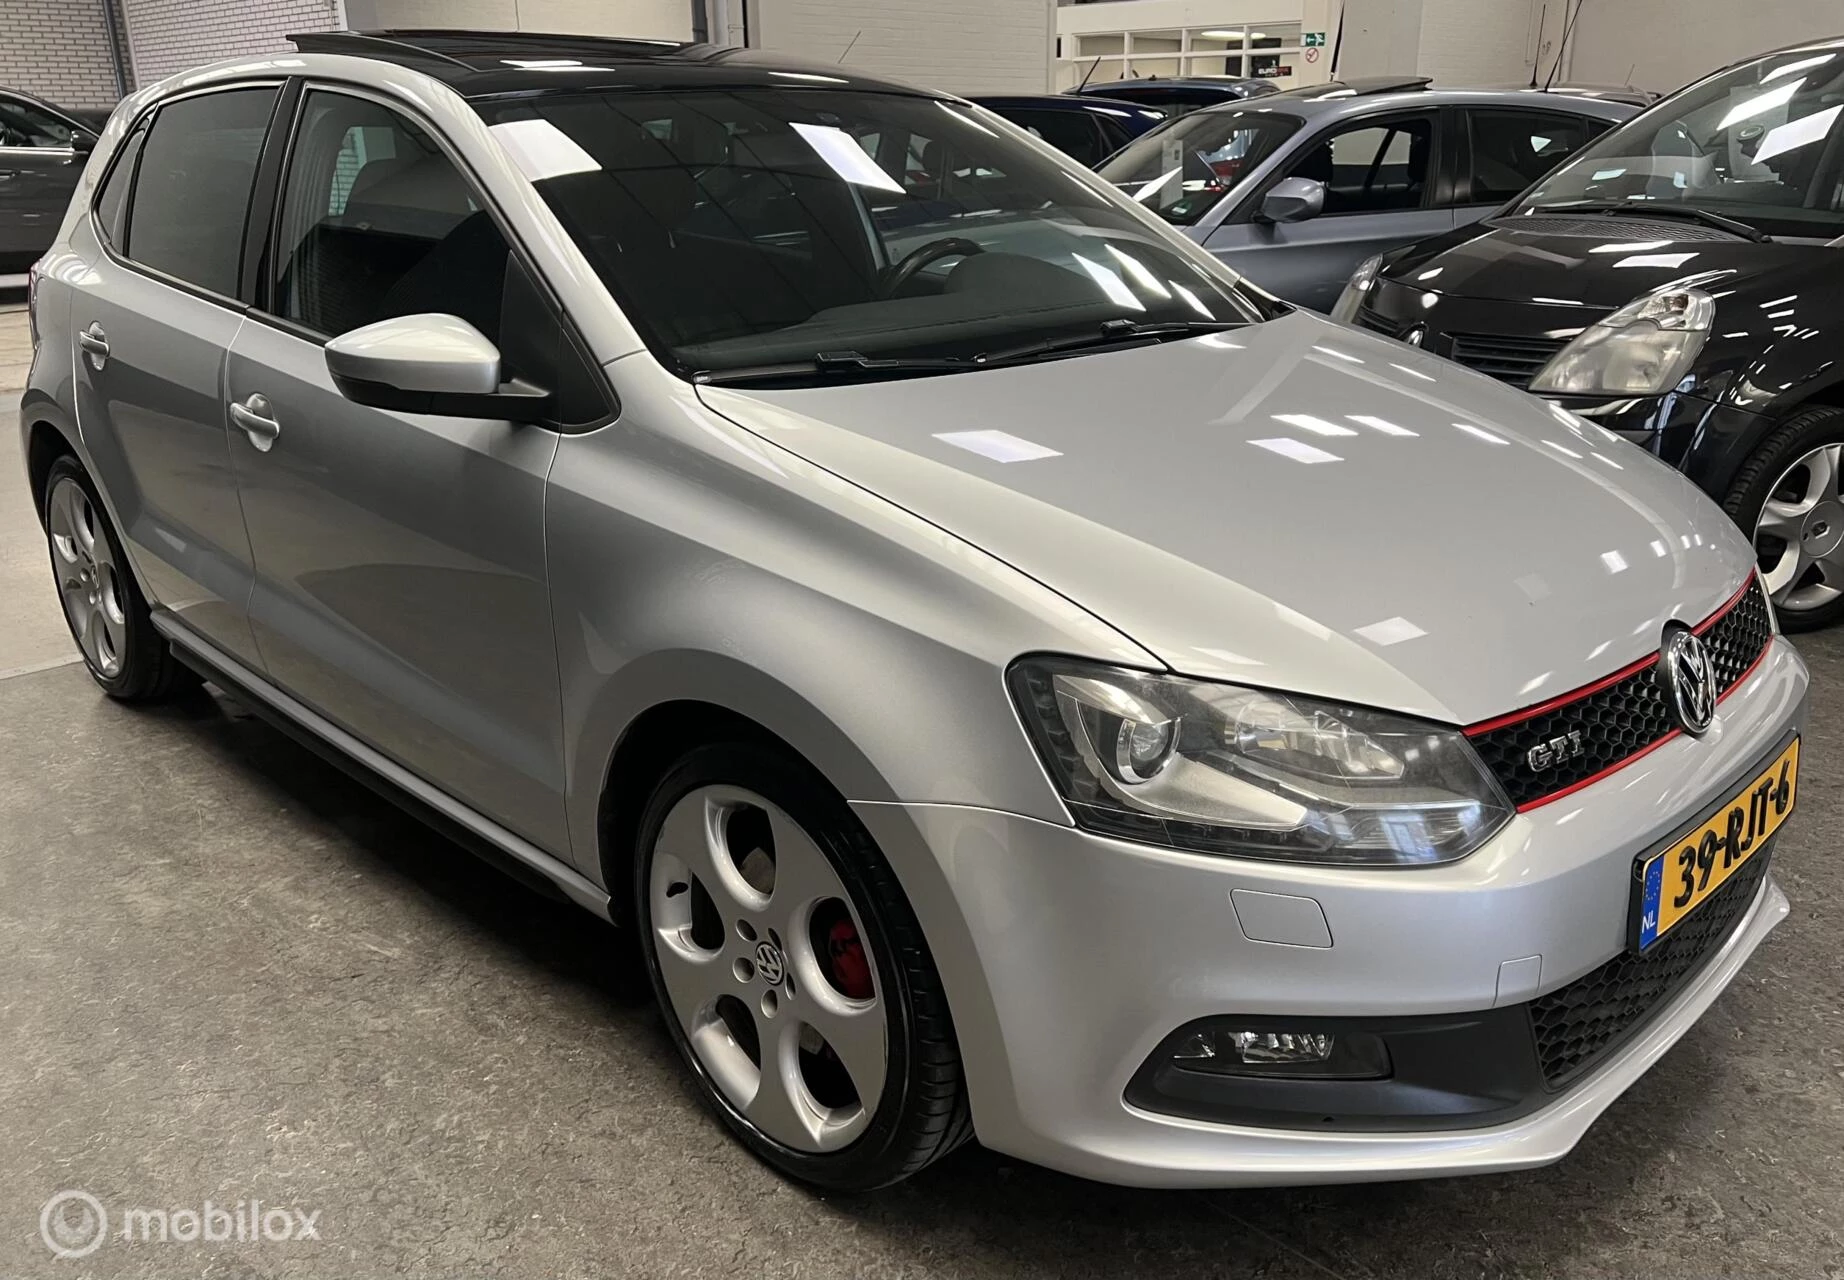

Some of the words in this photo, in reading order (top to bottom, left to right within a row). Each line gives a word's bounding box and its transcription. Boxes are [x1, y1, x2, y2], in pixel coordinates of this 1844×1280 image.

[1527, 730, 1585, 772] GTI
[1673, 760, 1790, 908] 39-RJT-6
[1641, 910, 1656, 934] NL
